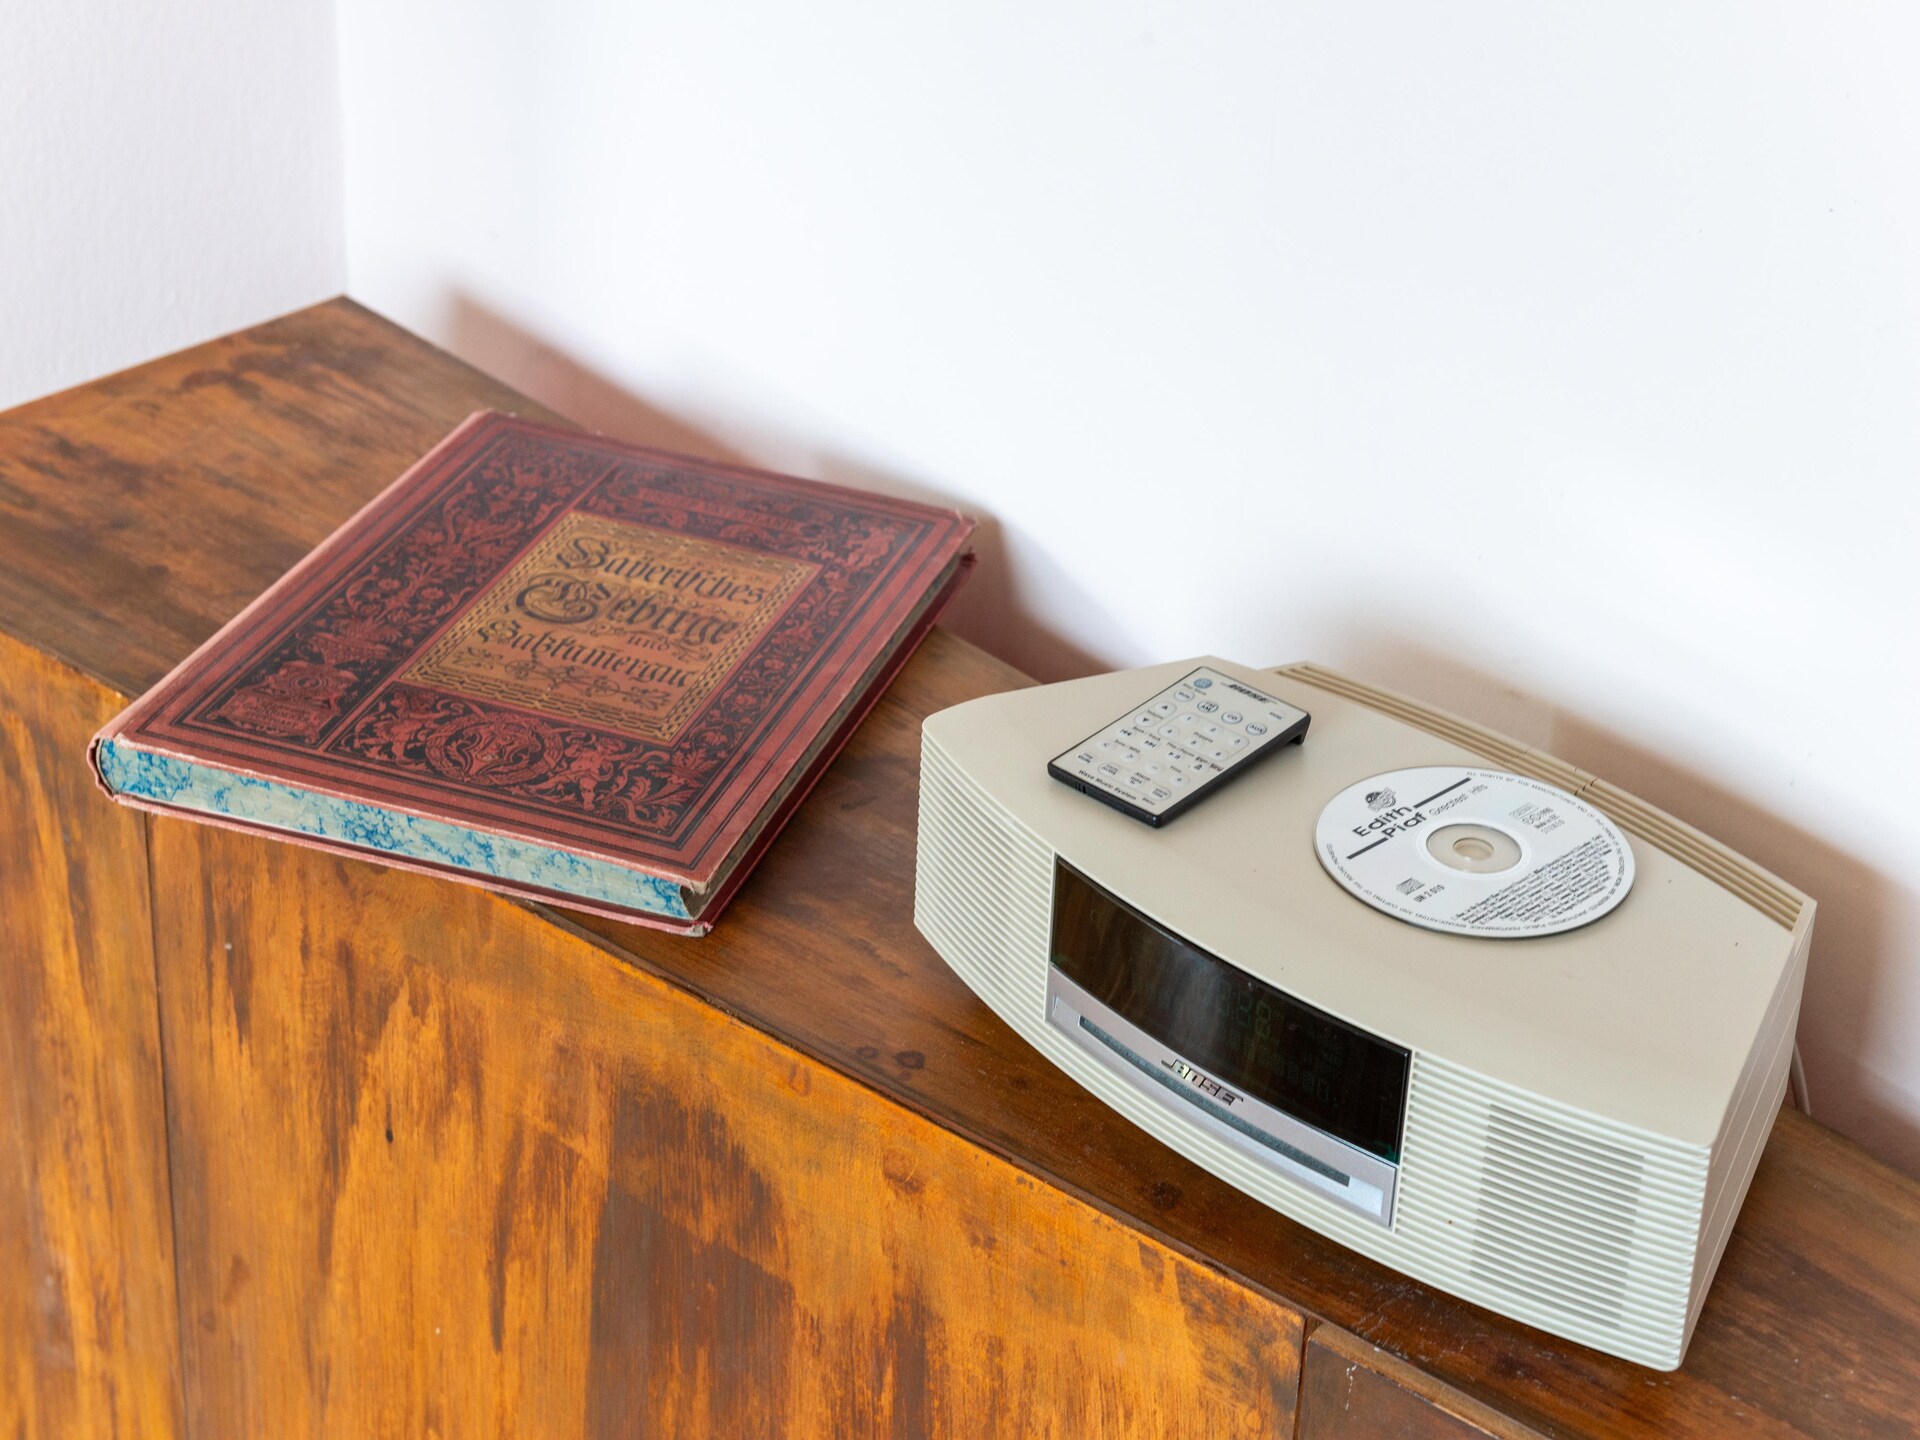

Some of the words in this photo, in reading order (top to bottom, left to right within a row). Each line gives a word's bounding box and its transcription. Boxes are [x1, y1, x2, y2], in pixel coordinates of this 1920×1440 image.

[1352, 805, 1413, 838] Edith
[1381, 811, 1427, 838] Piaf
[1428, 793, 1469, 816] Greatest
[1161, 1058, 1244, 1106] BOSE
